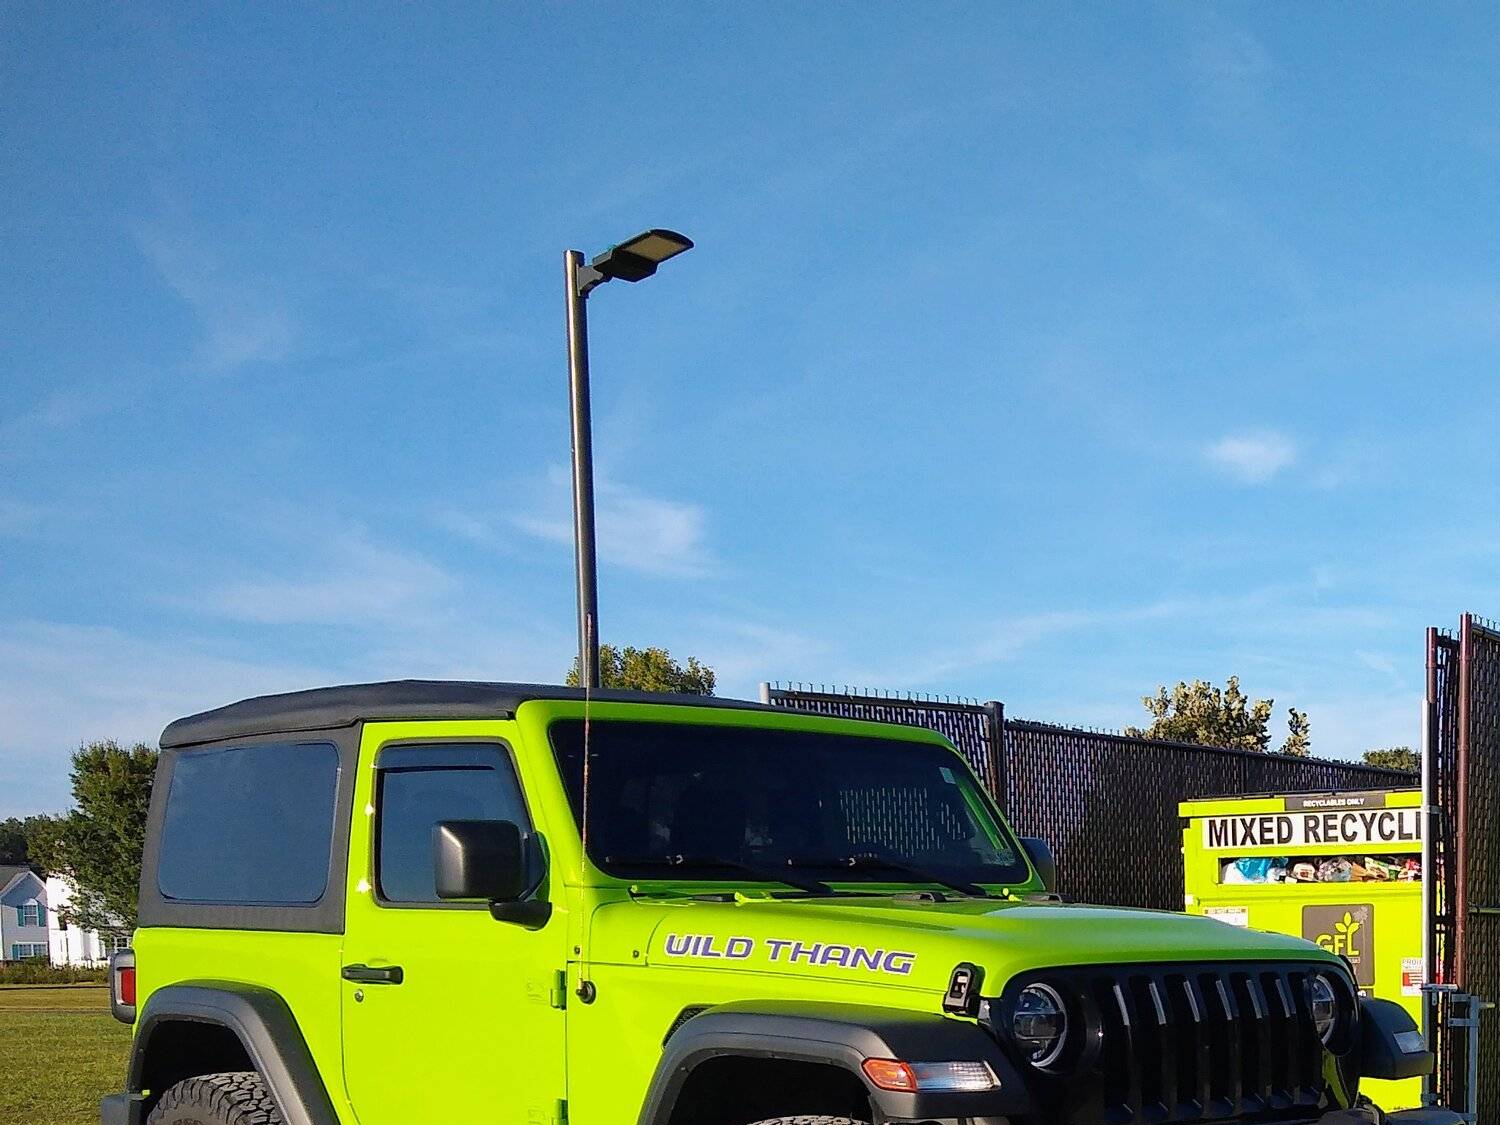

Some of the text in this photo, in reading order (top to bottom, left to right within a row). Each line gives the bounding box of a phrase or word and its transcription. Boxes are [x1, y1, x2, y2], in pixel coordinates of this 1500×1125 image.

[1303, 798, 1365, 808] RECYCLABLES ONLY
[1208, 816, 1294, 848] MIXED
[666, 935, 916, 974] WILD THANG
[1316, 922, 1360, 956] GFL
